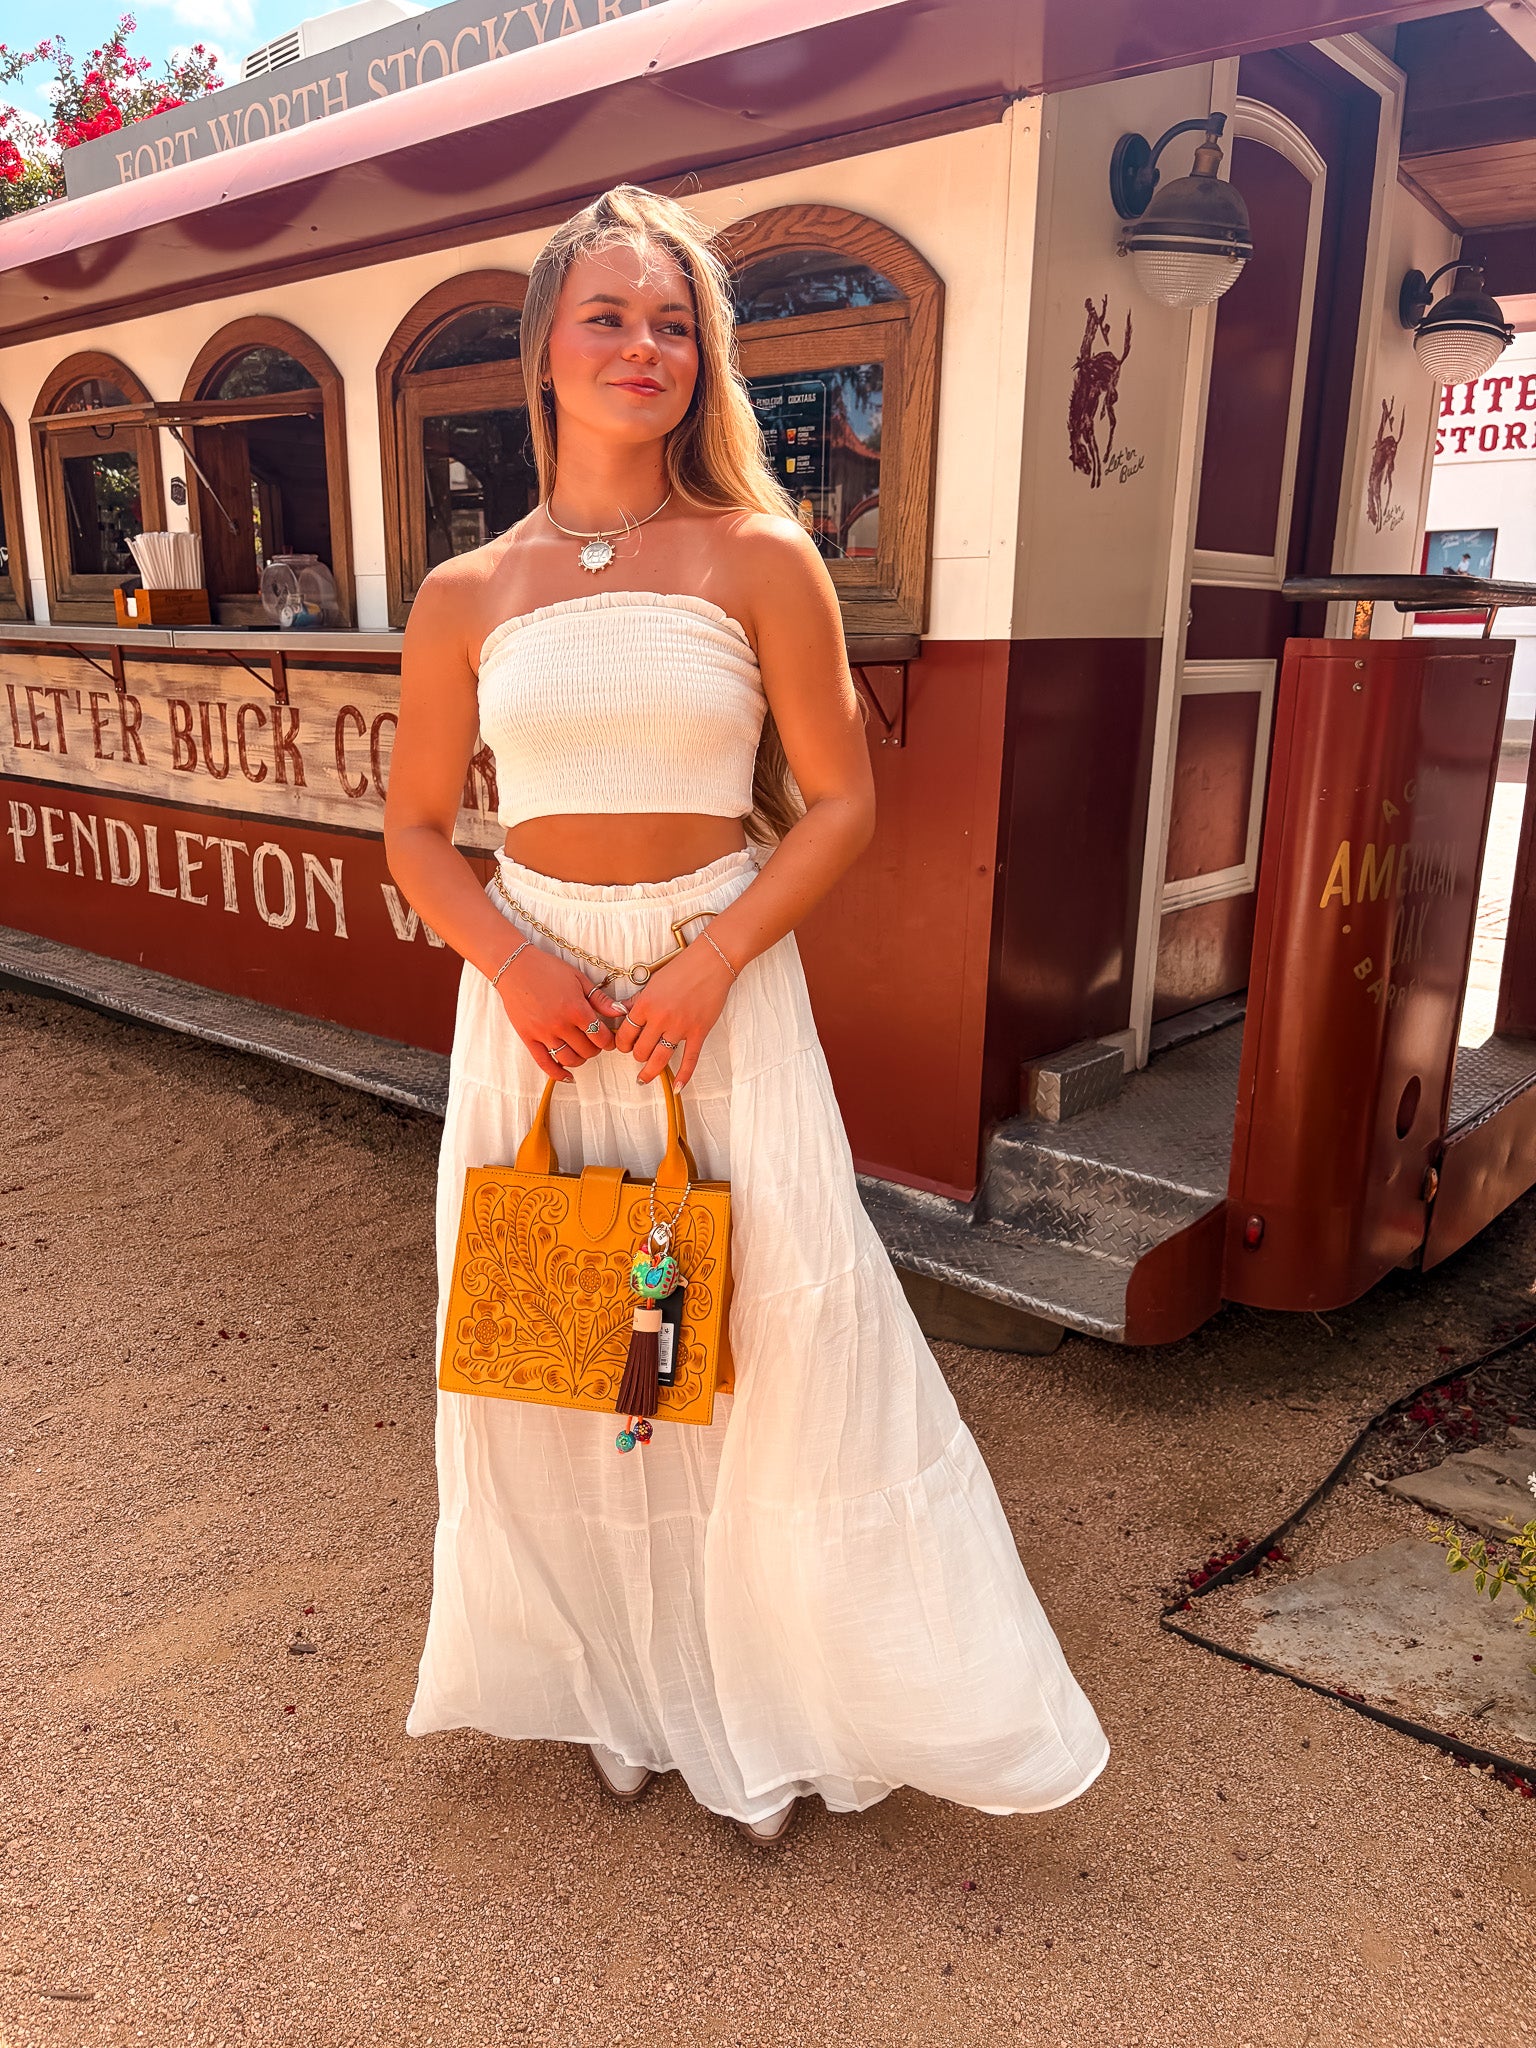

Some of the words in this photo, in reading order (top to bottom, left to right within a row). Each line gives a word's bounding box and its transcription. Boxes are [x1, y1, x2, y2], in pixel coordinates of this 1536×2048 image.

[115, 127, 198, 184] FORT
[207, 71, 349, 153] WORTH
[367, 0, 651, 102] STOCKYAR
[788, 394, 816, 404] COCKTAILS
[1434, 421, 1536, 455] STOR
[5, 684, 148, 766] LET'ER
[167, 698, 307, 788] BUCK
[7, 800, 349, 939] PENDLETON
